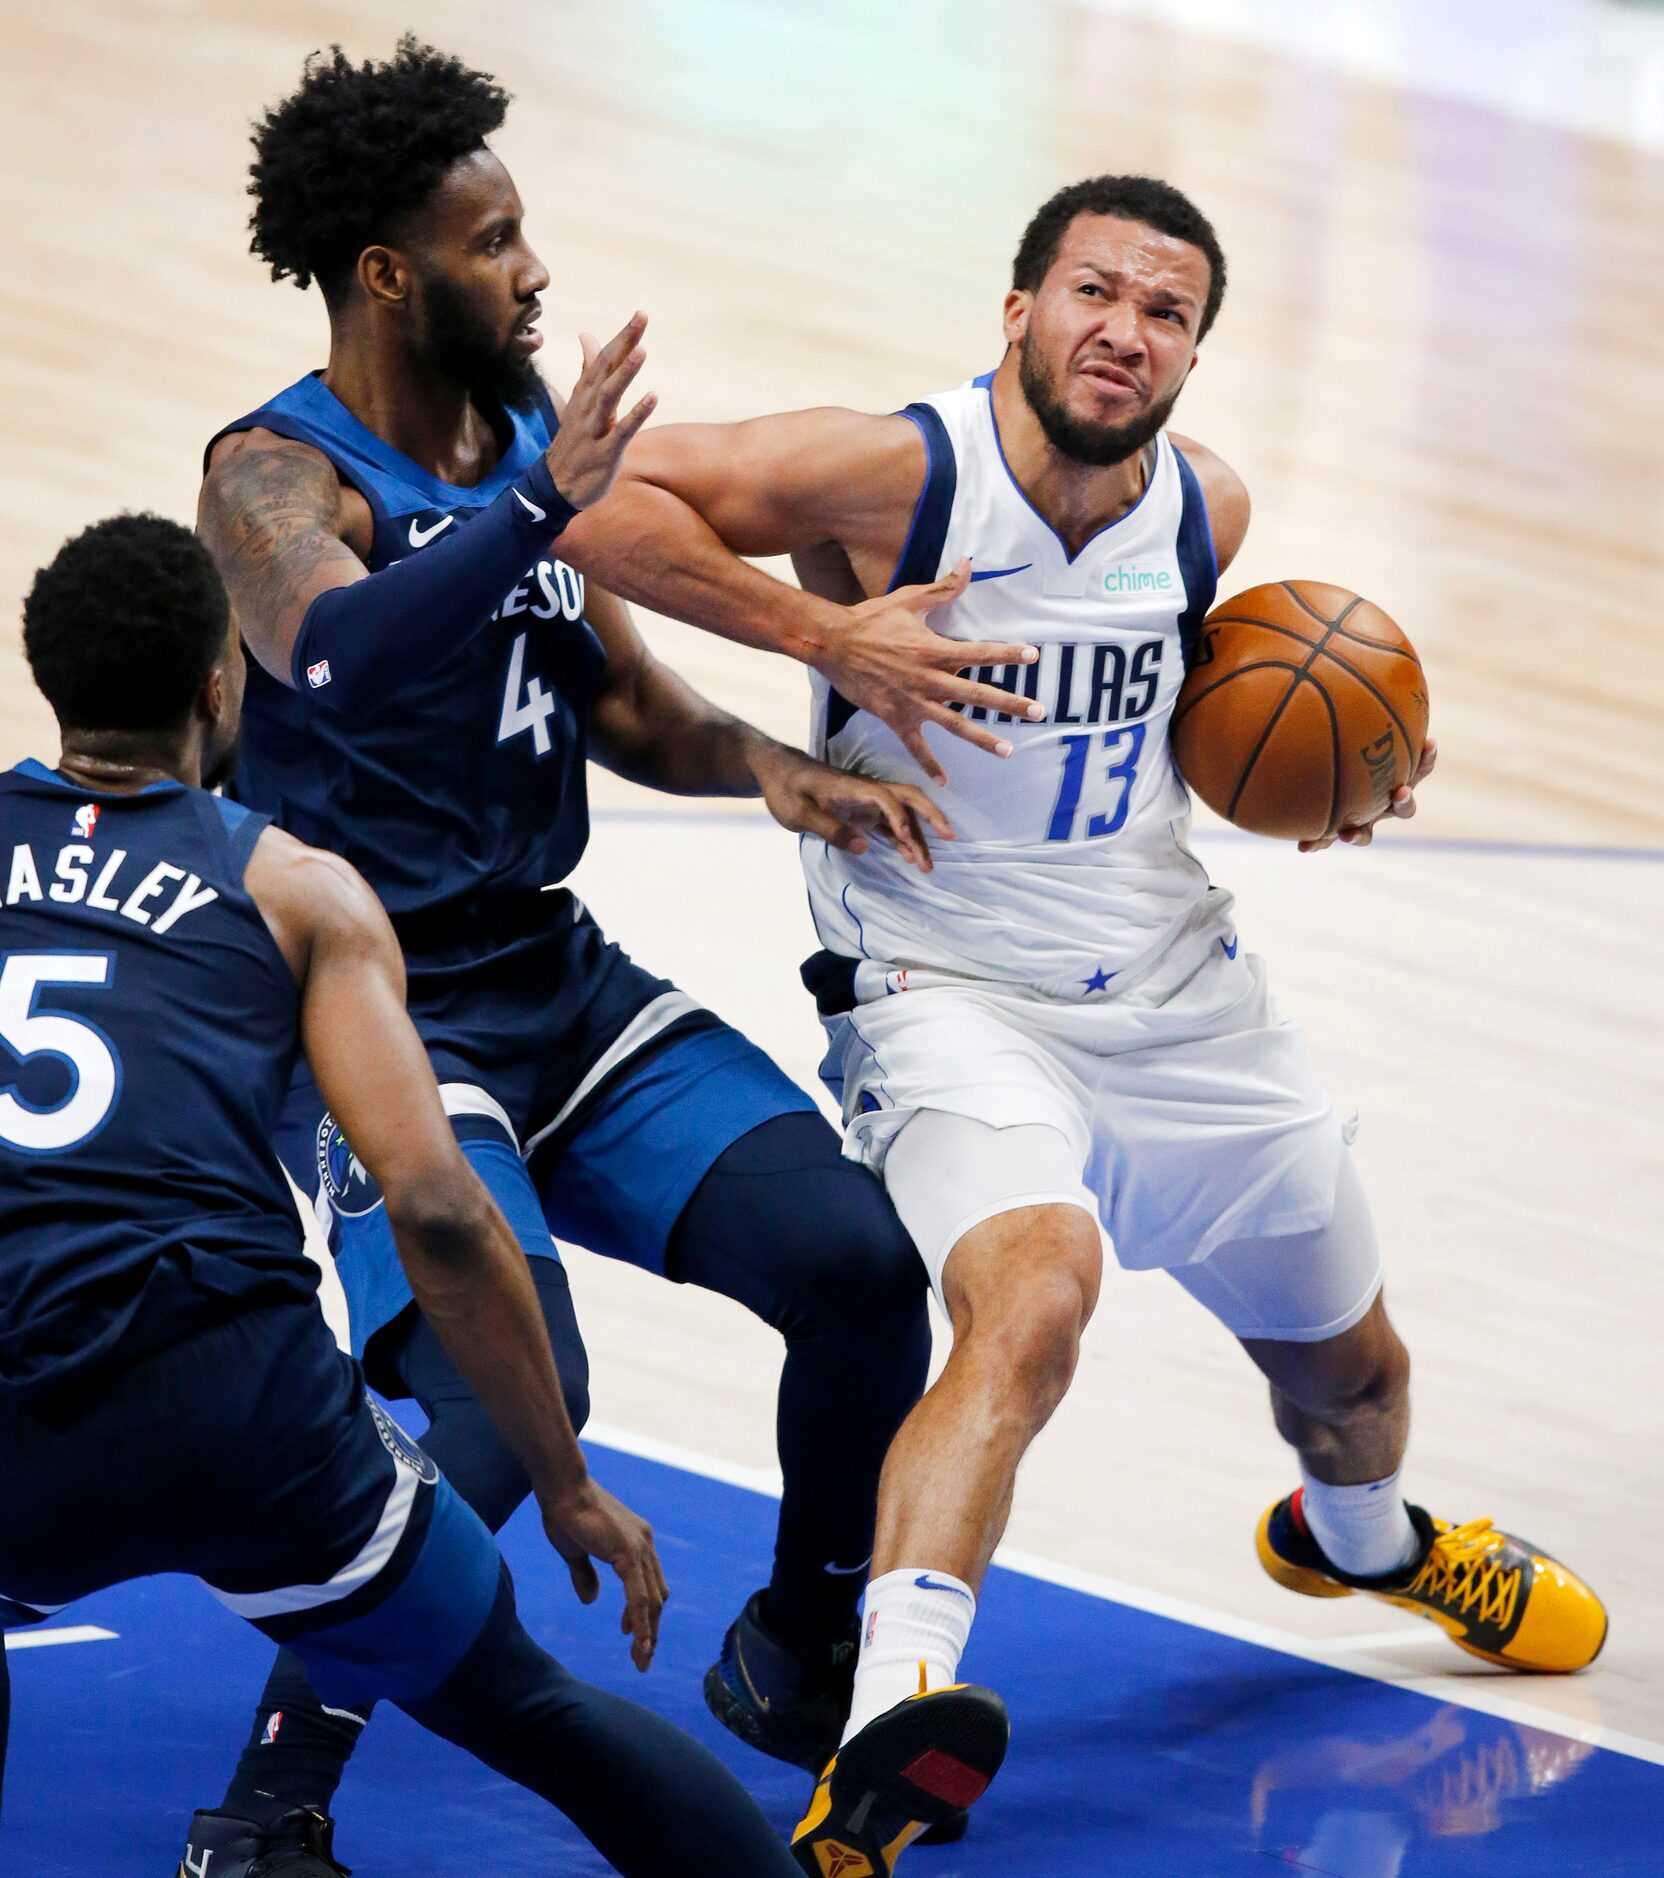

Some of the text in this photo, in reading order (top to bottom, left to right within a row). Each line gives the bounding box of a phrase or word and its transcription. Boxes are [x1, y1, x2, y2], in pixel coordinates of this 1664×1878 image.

[491, 559, 584, 621] ESO
[1103, 566, 1172, 593] chime
[497, 631, 555, 756] 4
[944, 637, 1164, 726] LLAS
[1044, 722, 1147, 842] 13
[0, 843, 219, 935] ASLEY
[0, 952, 120, 1153] 5
[319, 1118, 336, 1198] MINNESOT
